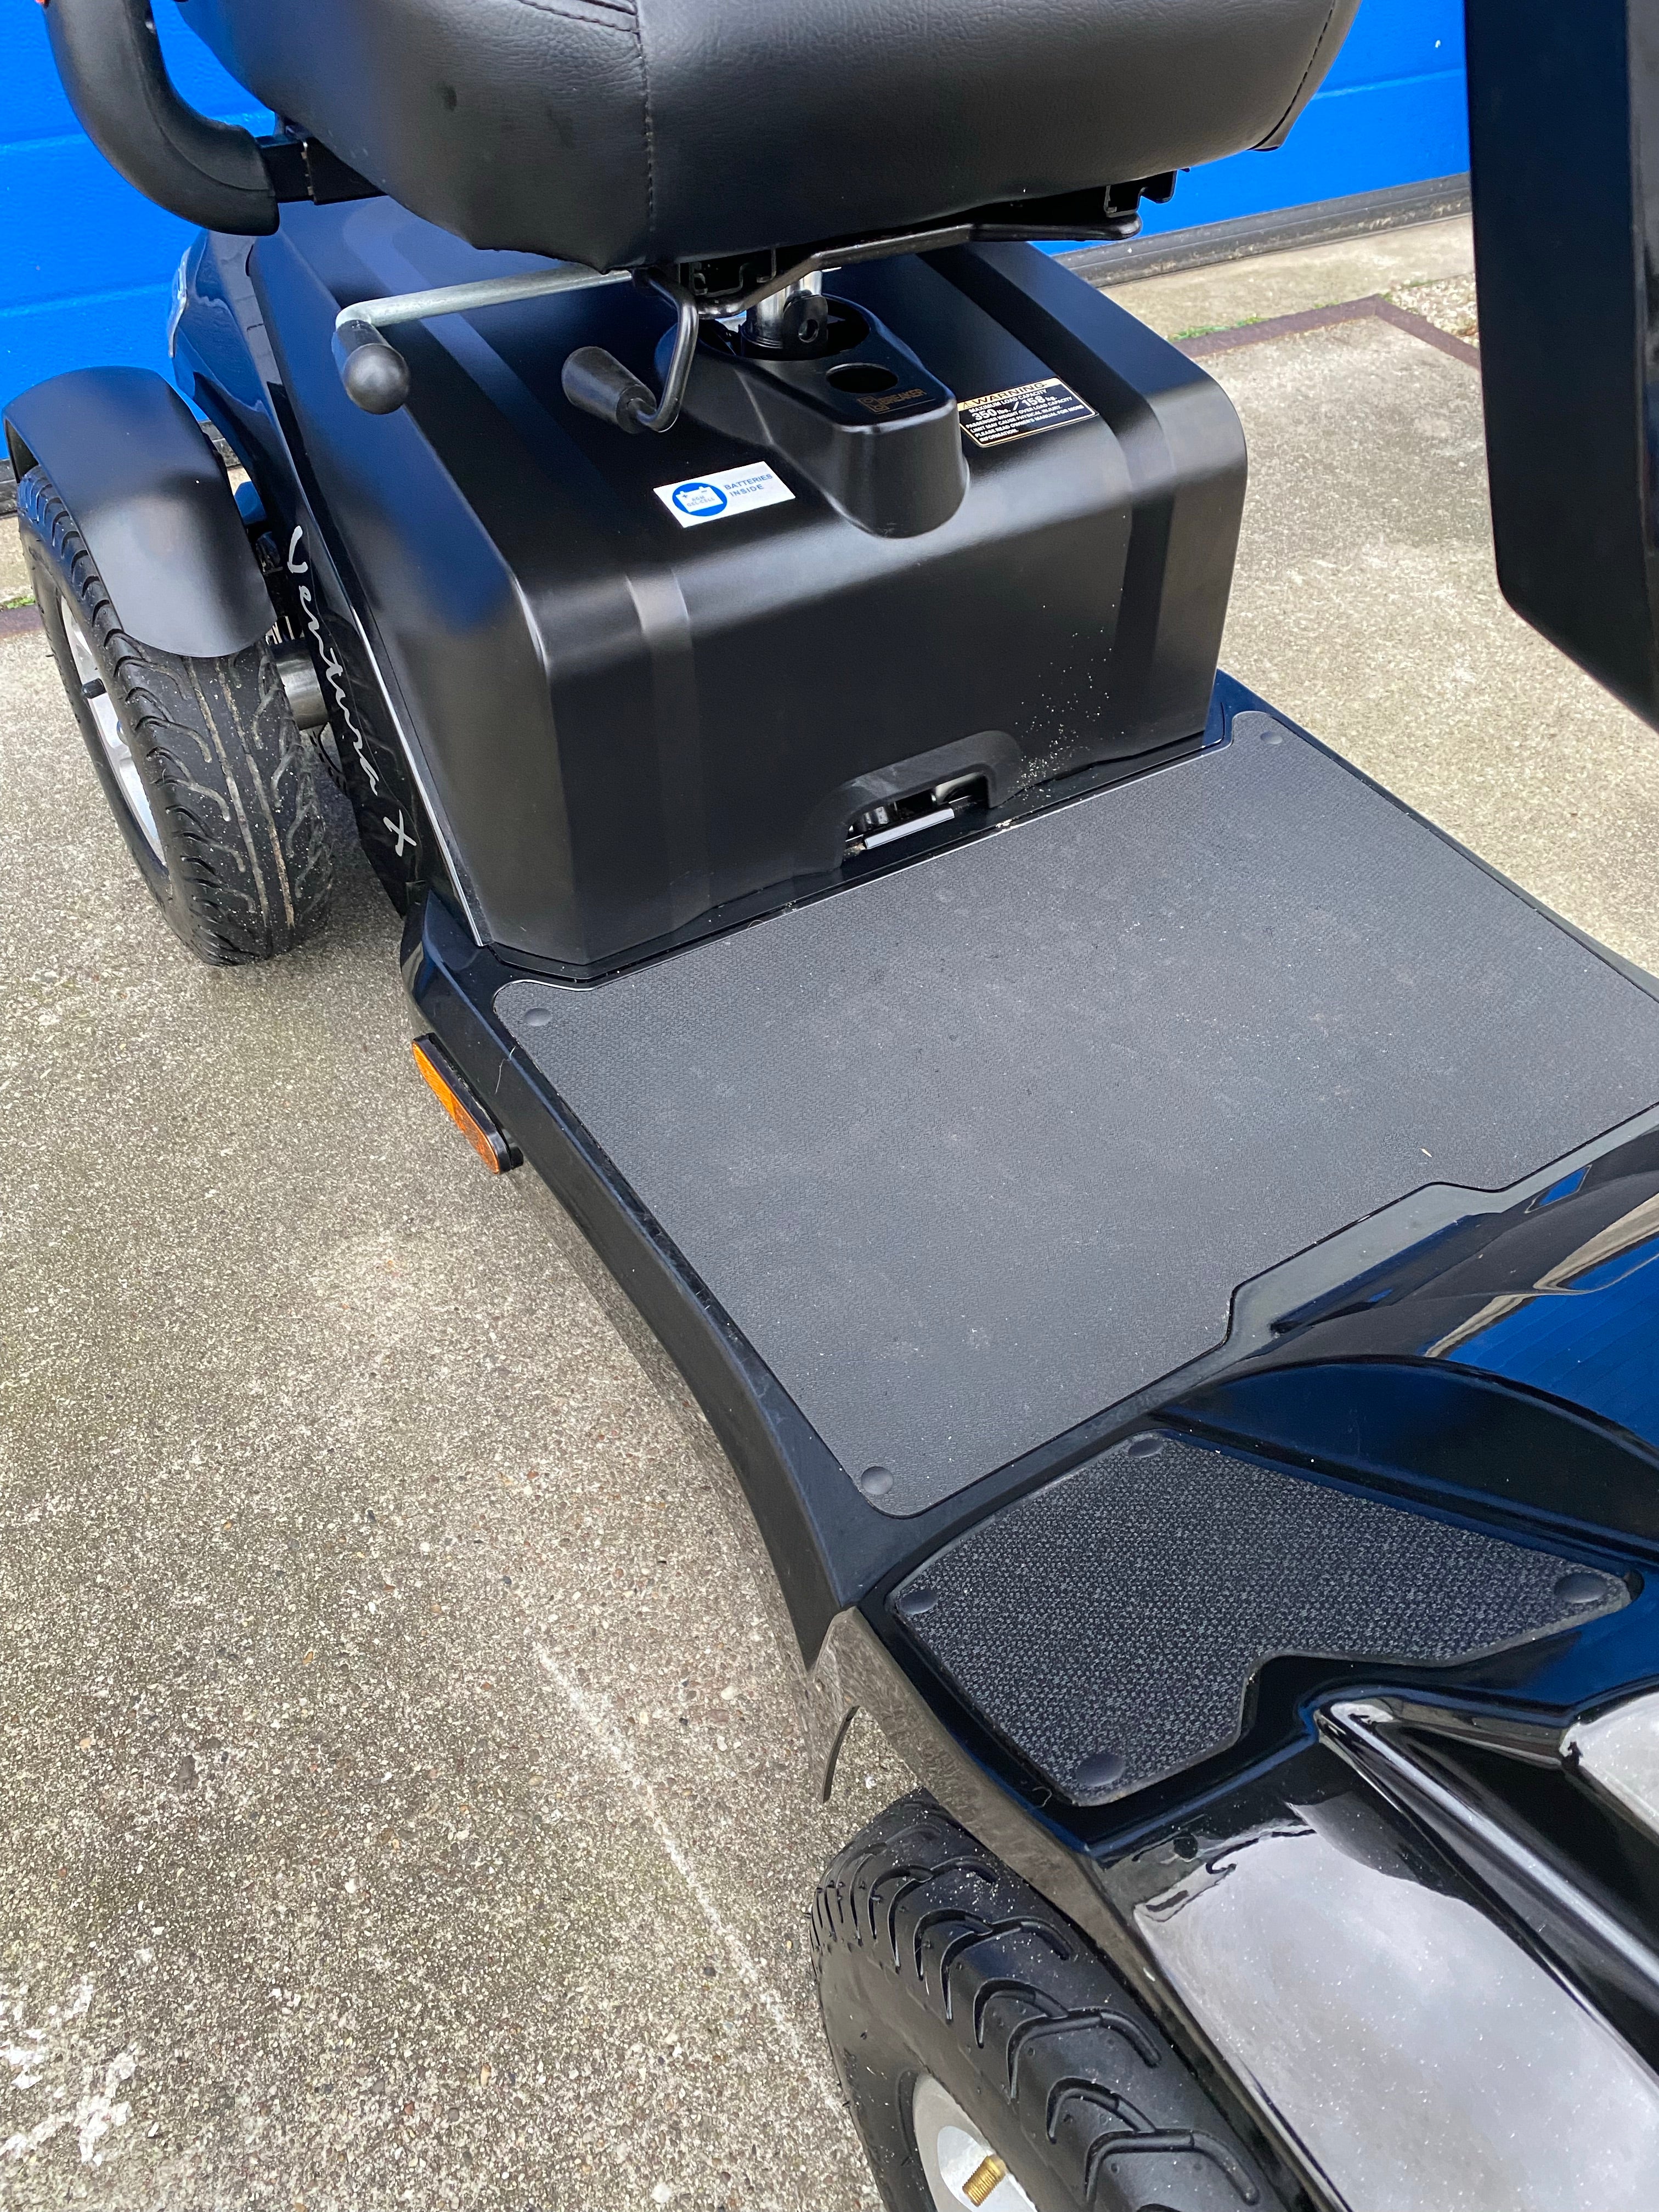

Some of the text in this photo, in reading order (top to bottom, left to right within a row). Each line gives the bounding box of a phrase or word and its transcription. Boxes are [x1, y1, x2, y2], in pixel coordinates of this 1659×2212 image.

[877, 388, 928, 405] BREAKER
[968, 402, 1001, 413] MAXIMUM
[1018, 389, 1047, 400] CAPACITY
[972, 382, 1045, 404] WARNING
[966, 417, 998, 428] PASSENGER
[997, 411, 1019, 420] WEIGHT
[1047, 396, 1073, 406] CAPACITY
[972, 408, 997, 421] 350
[1022, 396, 1045, 407] 158
[1016, 410, 1042, 421] PHYSICAL
[975, 429, 996, 438] PLEASE
[1034, 413, 1058, 421] MANUAL
[724, 473, 773, 490] BATTERIES
[729, 484, 764, 496] INSIDE
[287, 525, 417, 857] Ventura X
